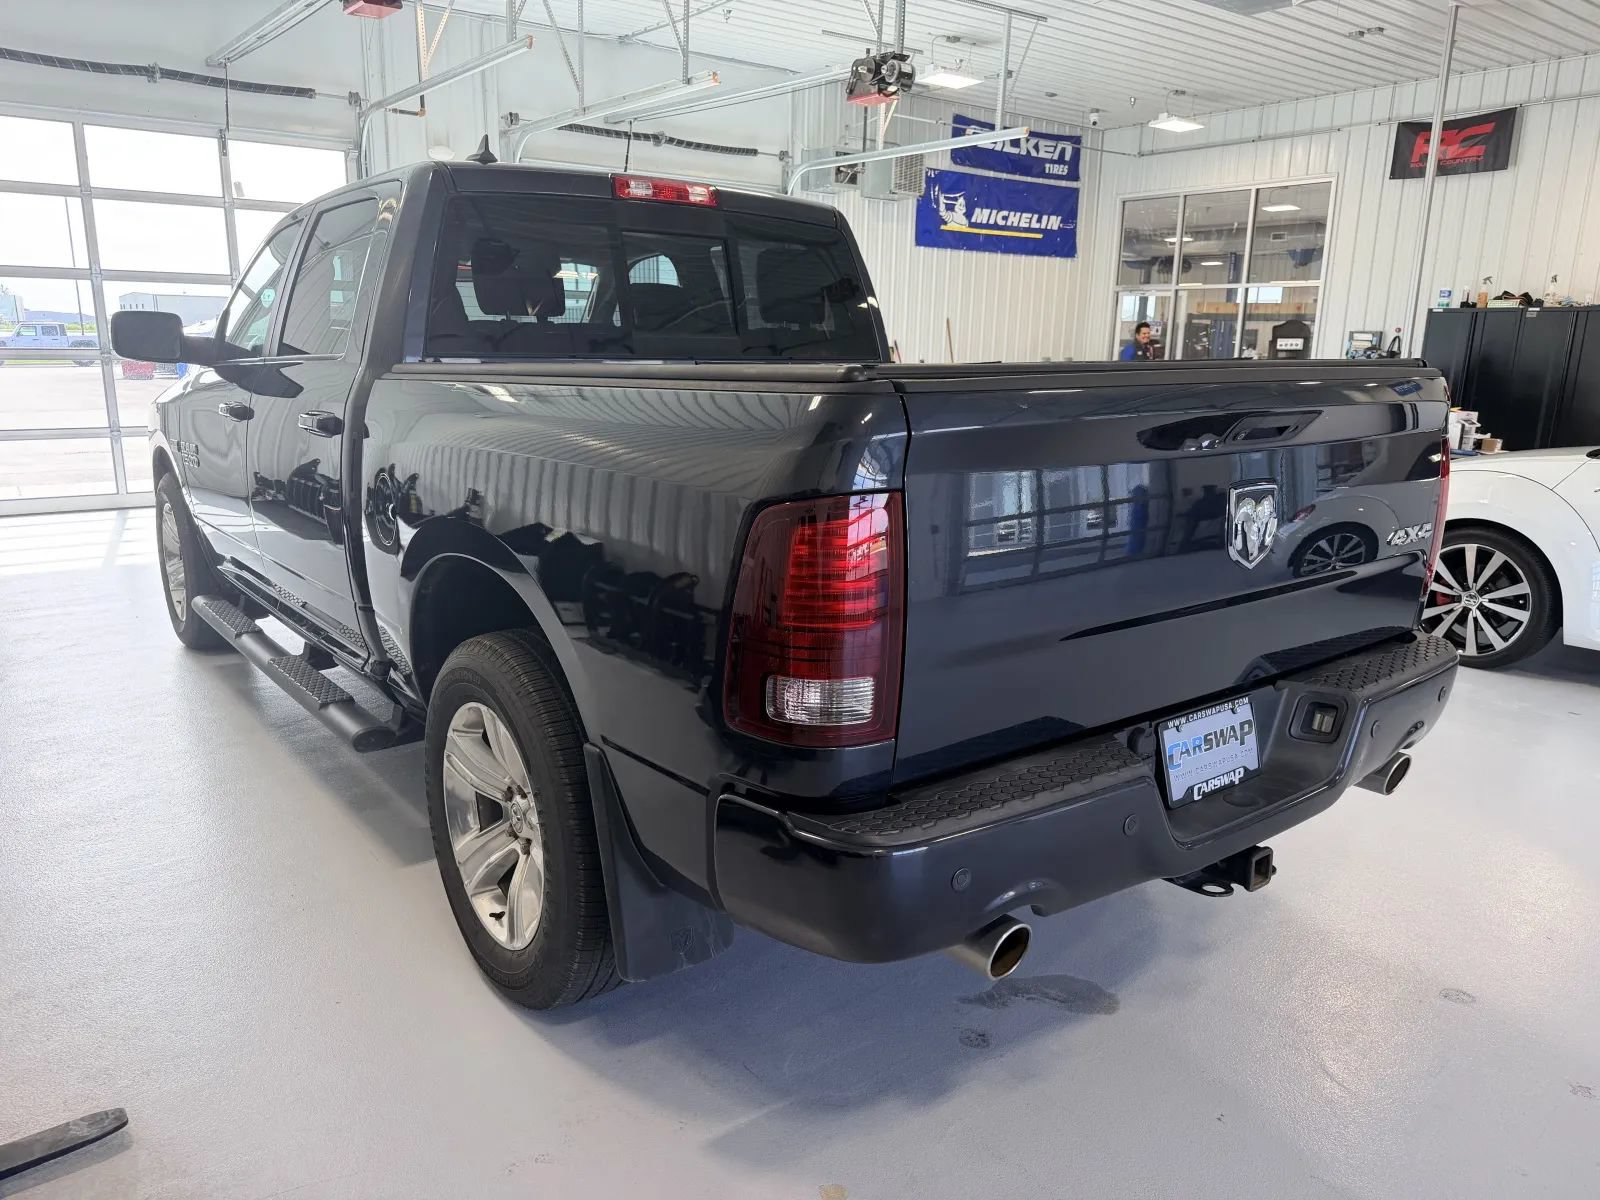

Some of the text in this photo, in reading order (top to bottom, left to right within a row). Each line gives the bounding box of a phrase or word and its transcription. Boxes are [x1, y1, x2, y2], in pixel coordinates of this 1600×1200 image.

[1045, 163, 1069, 176] TIRES
[971, 207, 1062, 231] MICHELIN
[1167, 697, 1249, 729] WWW.CARSWAPUSA.COM
